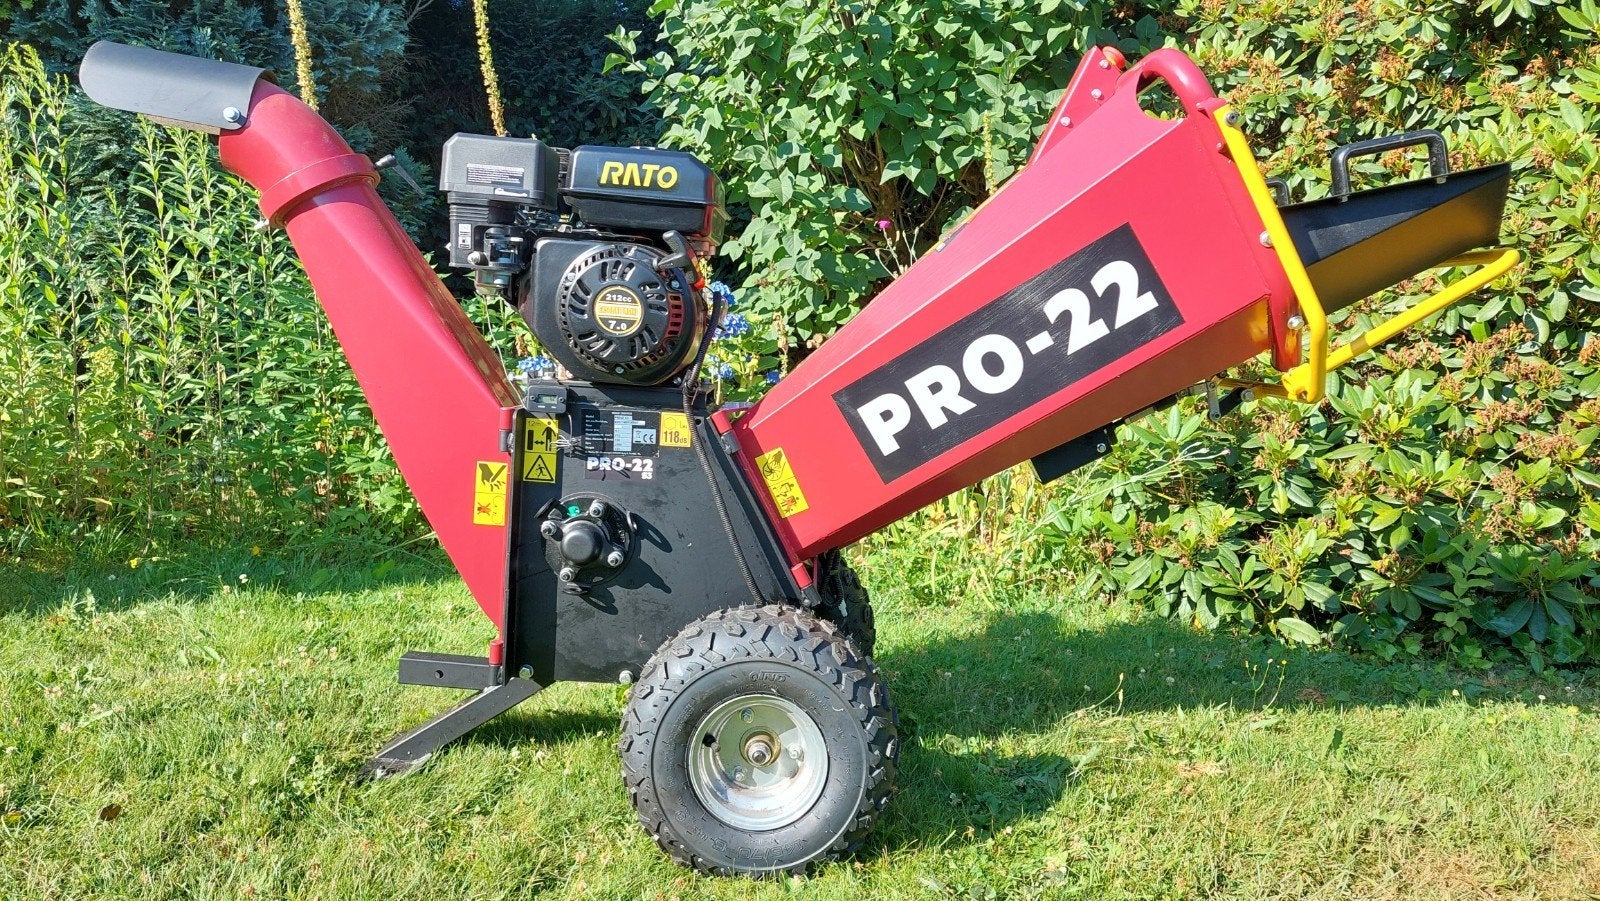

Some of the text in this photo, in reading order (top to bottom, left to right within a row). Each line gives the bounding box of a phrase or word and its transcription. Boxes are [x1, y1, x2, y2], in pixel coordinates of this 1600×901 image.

[600, 161, 678, 189] RATO
[605, 293, 632, 303] 212cc
[608, 320, 627, 331] 7.0
[856, 260, 1159, 457] PRO-22
[586, 456, 654, 472] PRO-22
